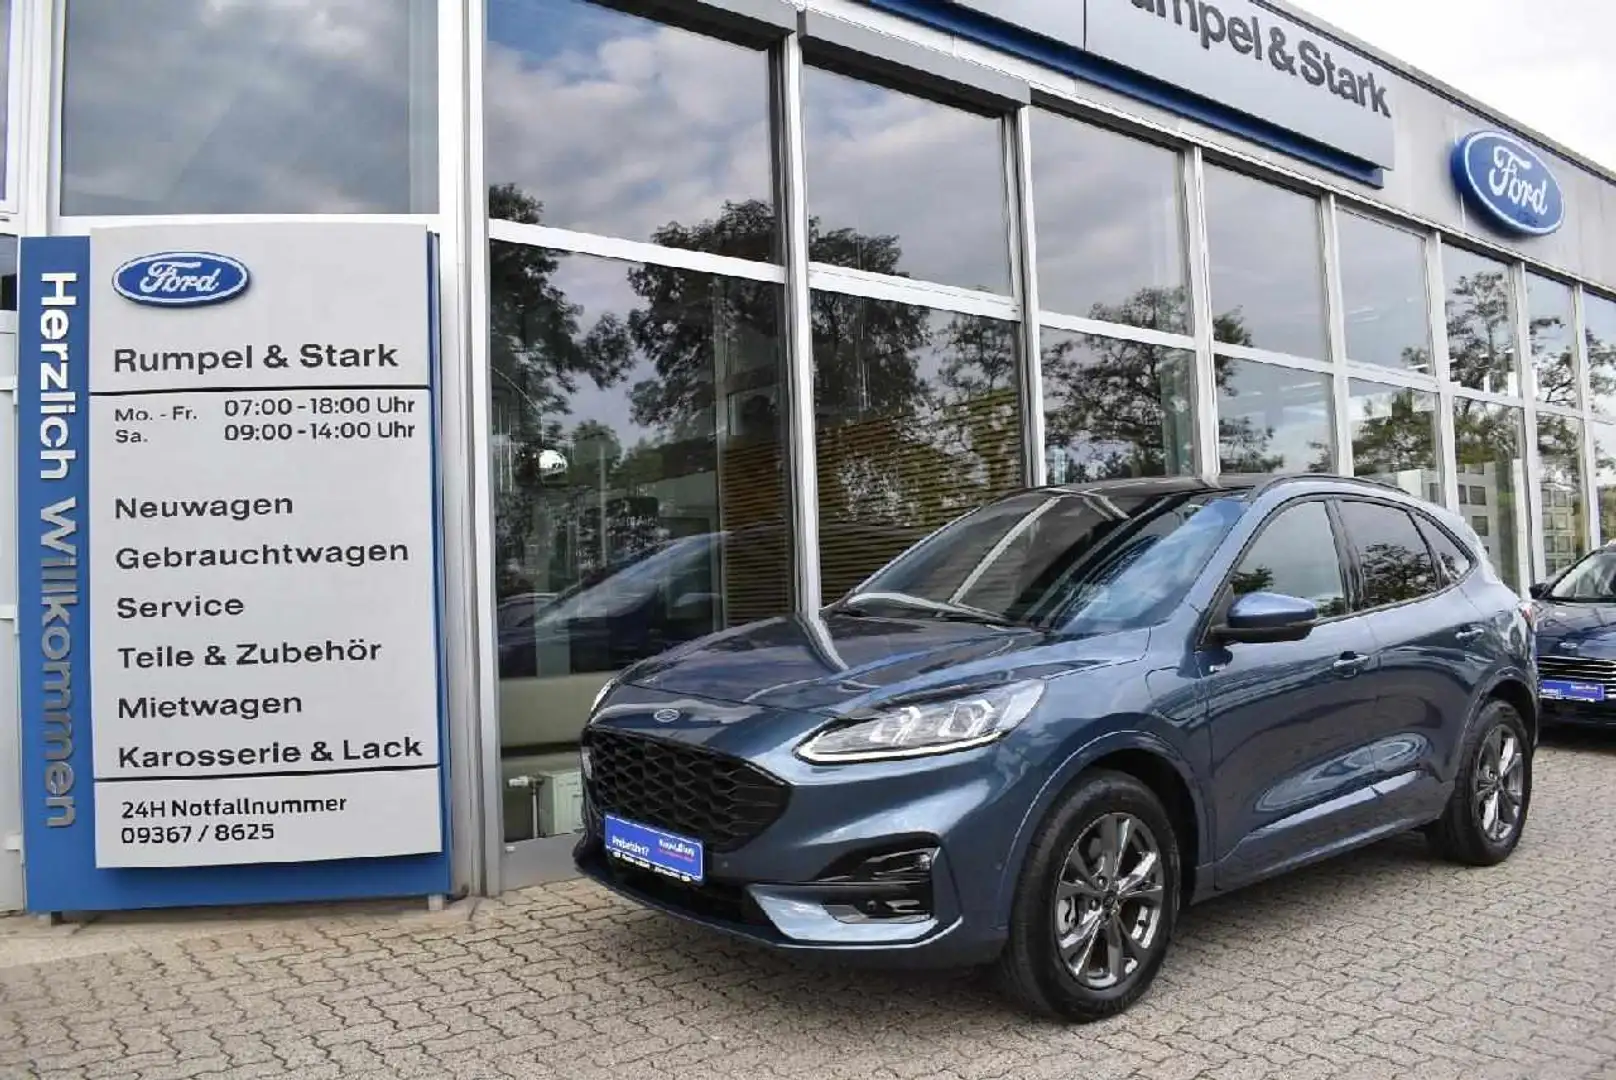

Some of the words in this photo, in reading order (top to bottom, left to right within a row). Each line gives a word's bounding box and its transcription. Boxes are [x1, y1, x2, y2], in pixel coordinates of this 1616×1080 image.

[1488, 146, 1548, 216] Ford
[140, 261, 221, 293] Ford
[114, 344, 253, 376] Rumpel
[262, 345, 290, 369] &
[299, 343, 399, 369] Stark
[40, 272, 77, 479] Herzlich
[115, 407, 153, 422] Mo.
[172, 405, 198, 421] Fr.
[376, 395, 416, 414] Uhr
[115, 429, 148, 444] Sa.
[377, 420, 416, 439] Uhr
[115, 497, 293, 521] Neuwagen
[115, 541, 409, 570] Gebrauchtwagen
[117, 595, 244, 619] Service
[40, 496, 79, 828] Willkommen
[117, 644, 195, 669] Teile
[204, 645, 227, 666] &
[235, 638, 382, 666] Zubehör
[118, 696, 302, 720] Mietwagen
[118, 742, 300, 769] Karosserie
[310, 741, 334, 762] &
[343, 736, 423, 761] Lack
[121, 800, 166, 820] 24H
[171, 797, 347, 818] Notfallnummer
[121, 825, 192, 844] 09367
[197, 824, 210, 843] /
[214, 823, 274, 842] 8625
